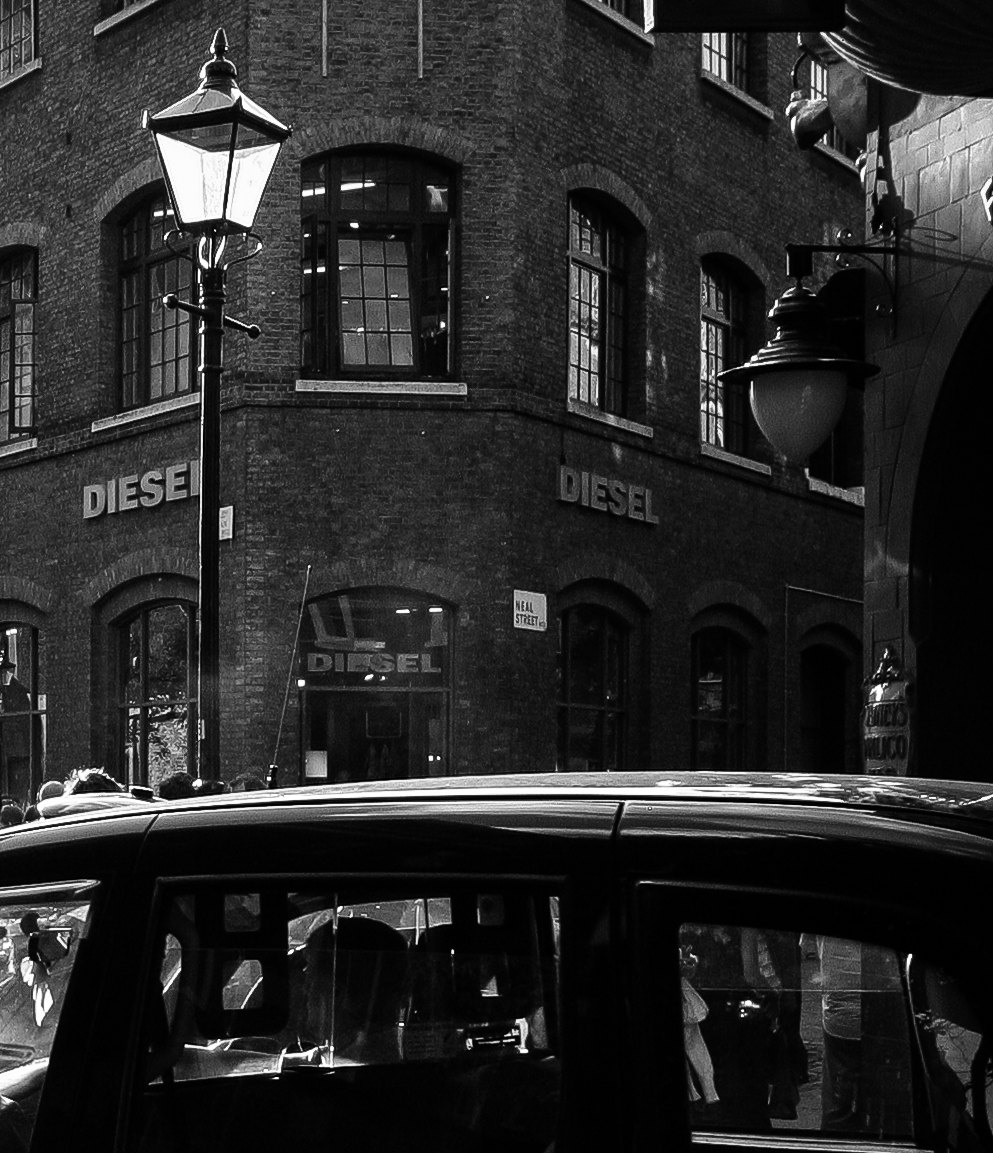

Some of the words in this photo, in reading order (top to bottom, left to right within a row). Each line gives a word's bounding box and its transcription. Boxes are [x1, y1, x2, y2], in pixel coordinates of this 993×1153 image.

[560, 465, 660, 525] DIESEL
[515, 600, 534, 614] NEAL
[515, 613, 539, 627] STREET
[307, 652, 442, 673] DIESEL
